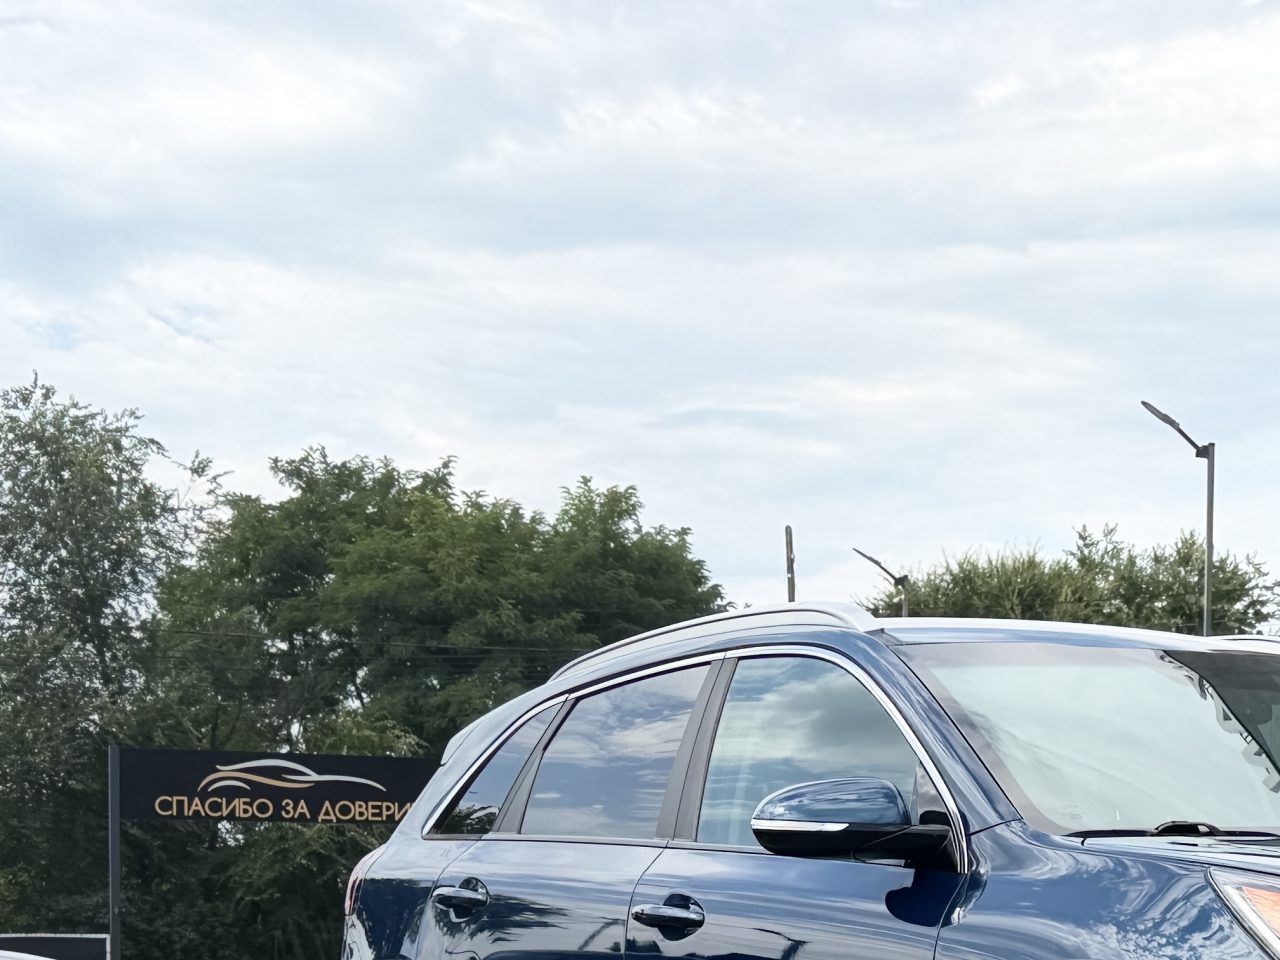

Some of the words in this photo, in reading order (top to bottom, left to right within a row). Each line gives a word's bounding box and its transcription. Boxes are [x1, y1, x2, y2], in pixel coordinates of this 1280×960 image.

[154, 795, 273, 818] СПАСИБО
[281, 799, 311, 819] ЗА
[317, 800, 412, 823] ДОВЕРИ
